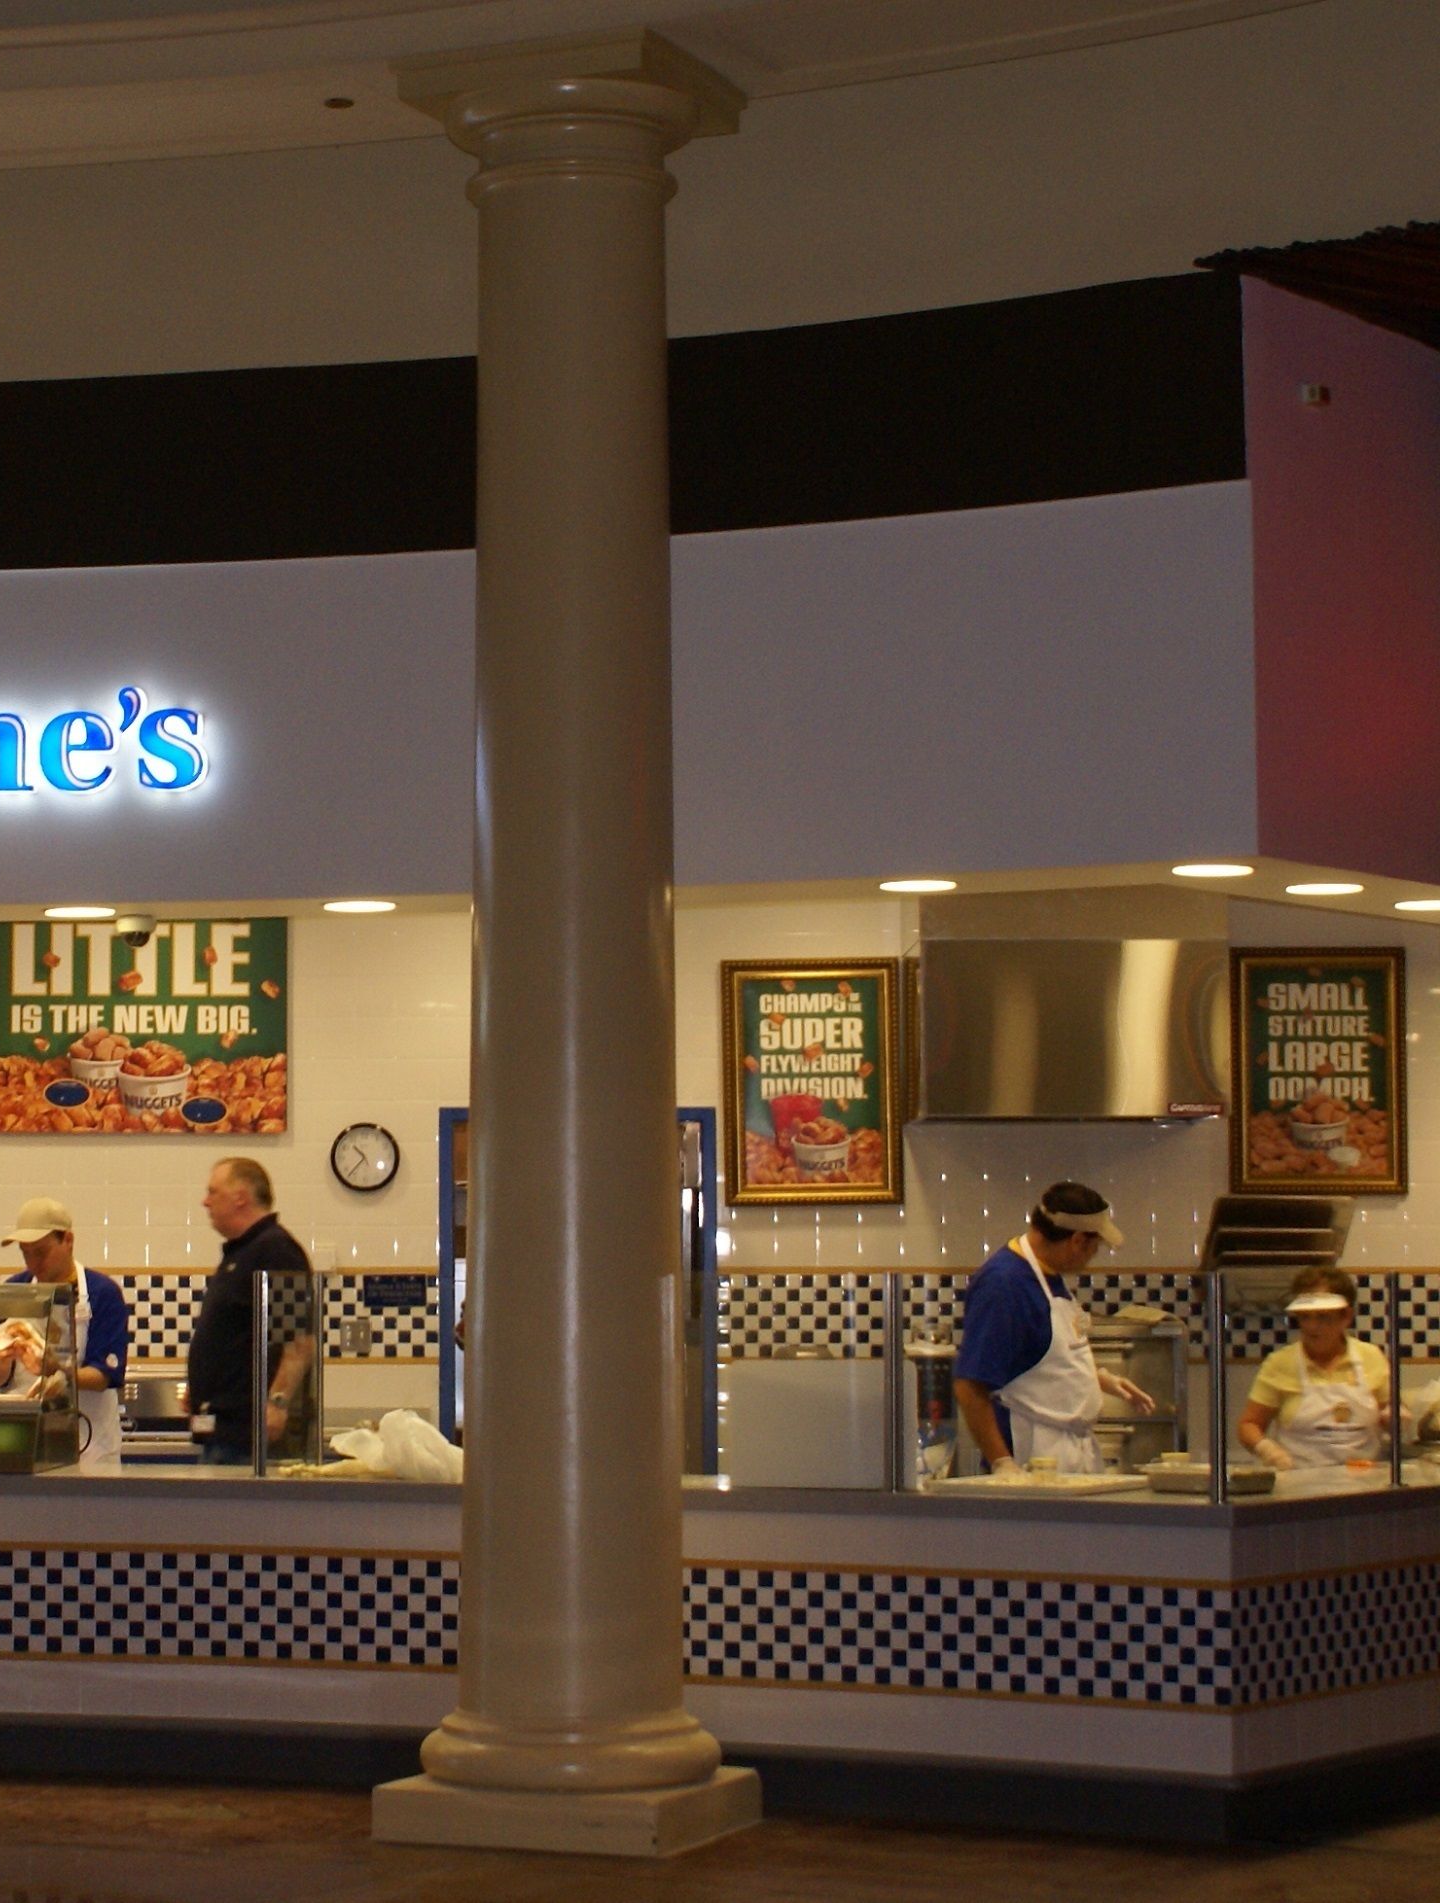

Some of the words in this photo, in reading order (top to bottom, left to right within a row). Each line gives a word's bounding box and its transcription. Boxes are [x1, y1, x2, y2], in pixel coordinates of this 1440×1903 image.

[11, 923, 251, 997] LITTLE
[759, 992, 846, 1014] CHAMPS
[1267, 982, 1368, 1011] SMALL
[11, 1005, 42, 1034] IS
[49, 1005, 105, 1033] THE
[113, 1005, 189, 1034] NEW
[197, 1005, 257, 1034] BIG.
[1268, 1015, 1369, 1037] STATURE
[759, 1017, 864, 1050] SUPER
[761, 1053, 864, 1074] FLYWEIGHT
[1268, 1041, 1369, 1073] LARGE
[74, 1075, 119, 1090] UGGET
[761, 1076, 869, 1100] DIVISION.
[1268, 1077, 1375, 1102] OOMPH.
[124, 1092, 182, 1110] NUGGETS
